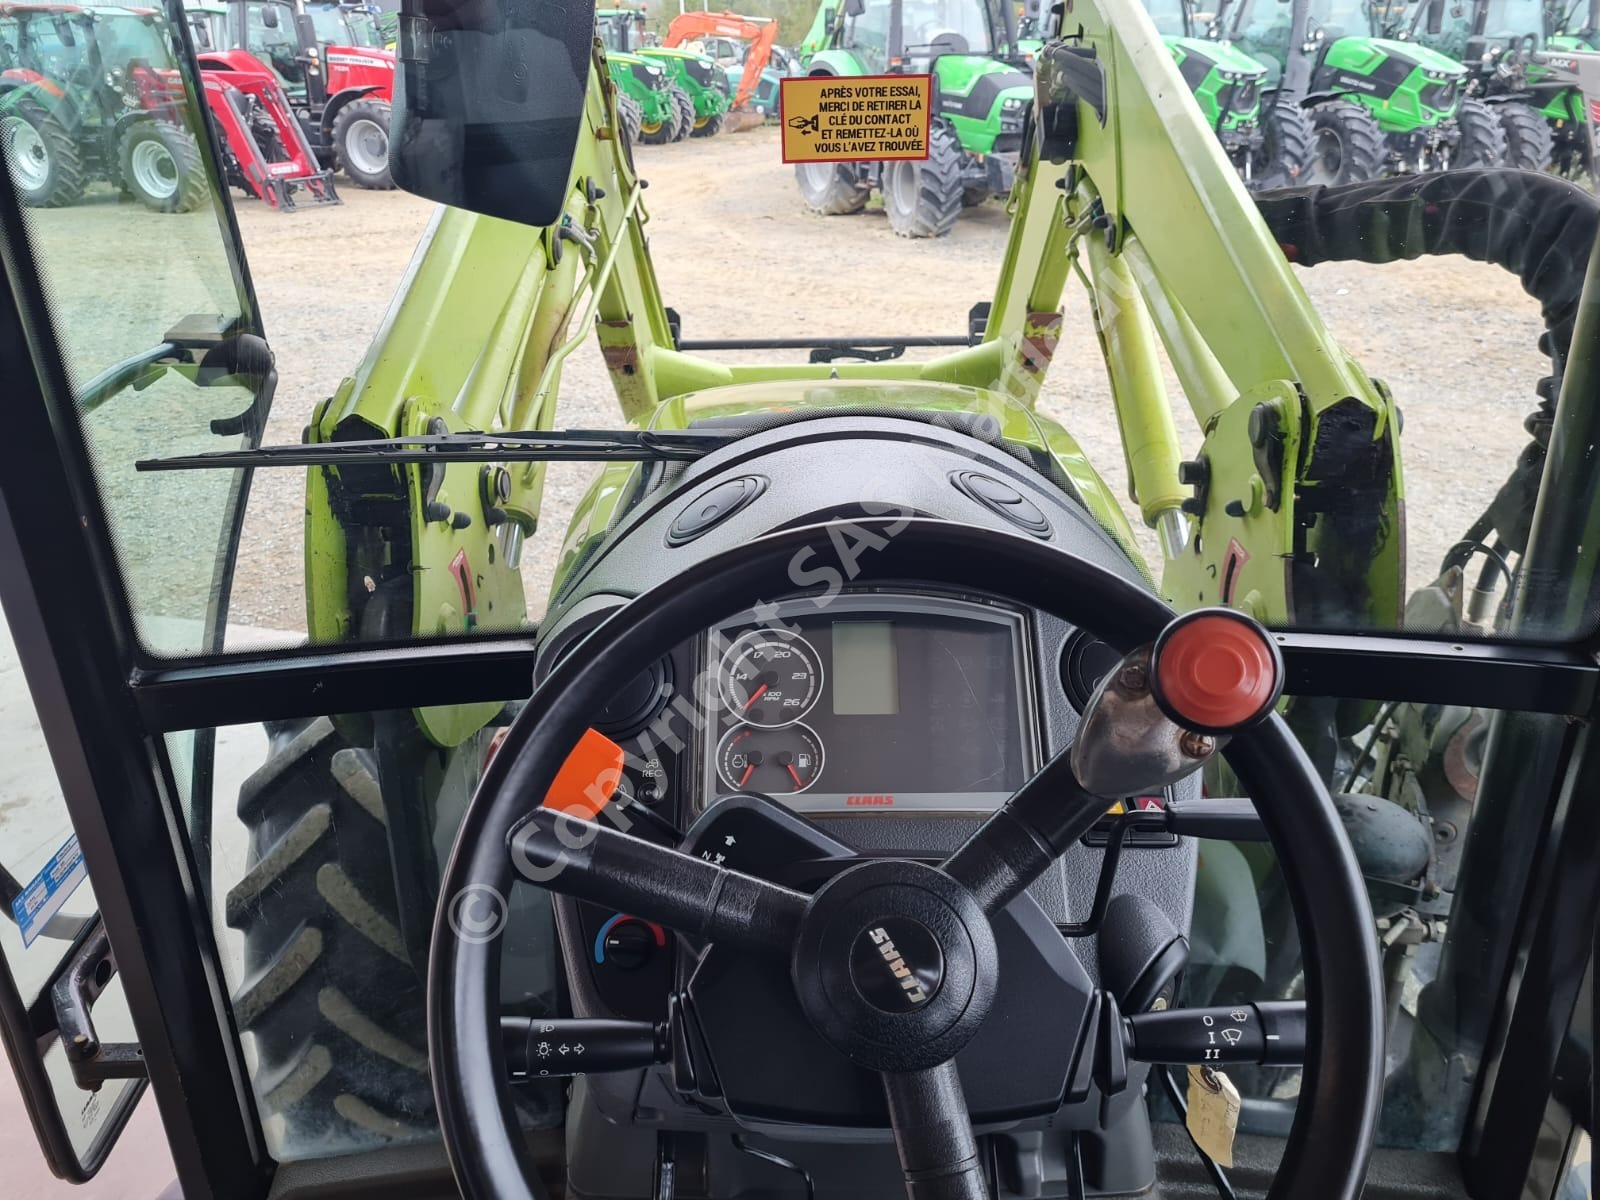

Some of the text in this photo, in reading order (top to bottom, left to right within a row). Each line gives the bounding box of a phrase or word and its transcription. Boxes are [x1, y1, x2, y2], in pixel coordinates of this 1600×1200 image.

[820, 86, 921, 98] APRÈS VOTRE ESSAI,
[819, 99, 922, 112] MERCI DE RETIRER LA
[829, 113, 911, 126] CLÉ DU CONTACT
[821, 125, 919, 140] ET REMETTEZ-LA OÙ
[814, 139, 925, 153] VOUS L'AVEZ TROUVÉE.
[774, 651, 792, 659] 20
[791, 672, 808, 680] 23
[783, 698, 801, 706] 26
[642, 769, 662, 778] REC
[846, 795, 894, 806] CLAAS
[702, 850, 712, 861] N
[868, 927, 927, 1003] CLAAS
